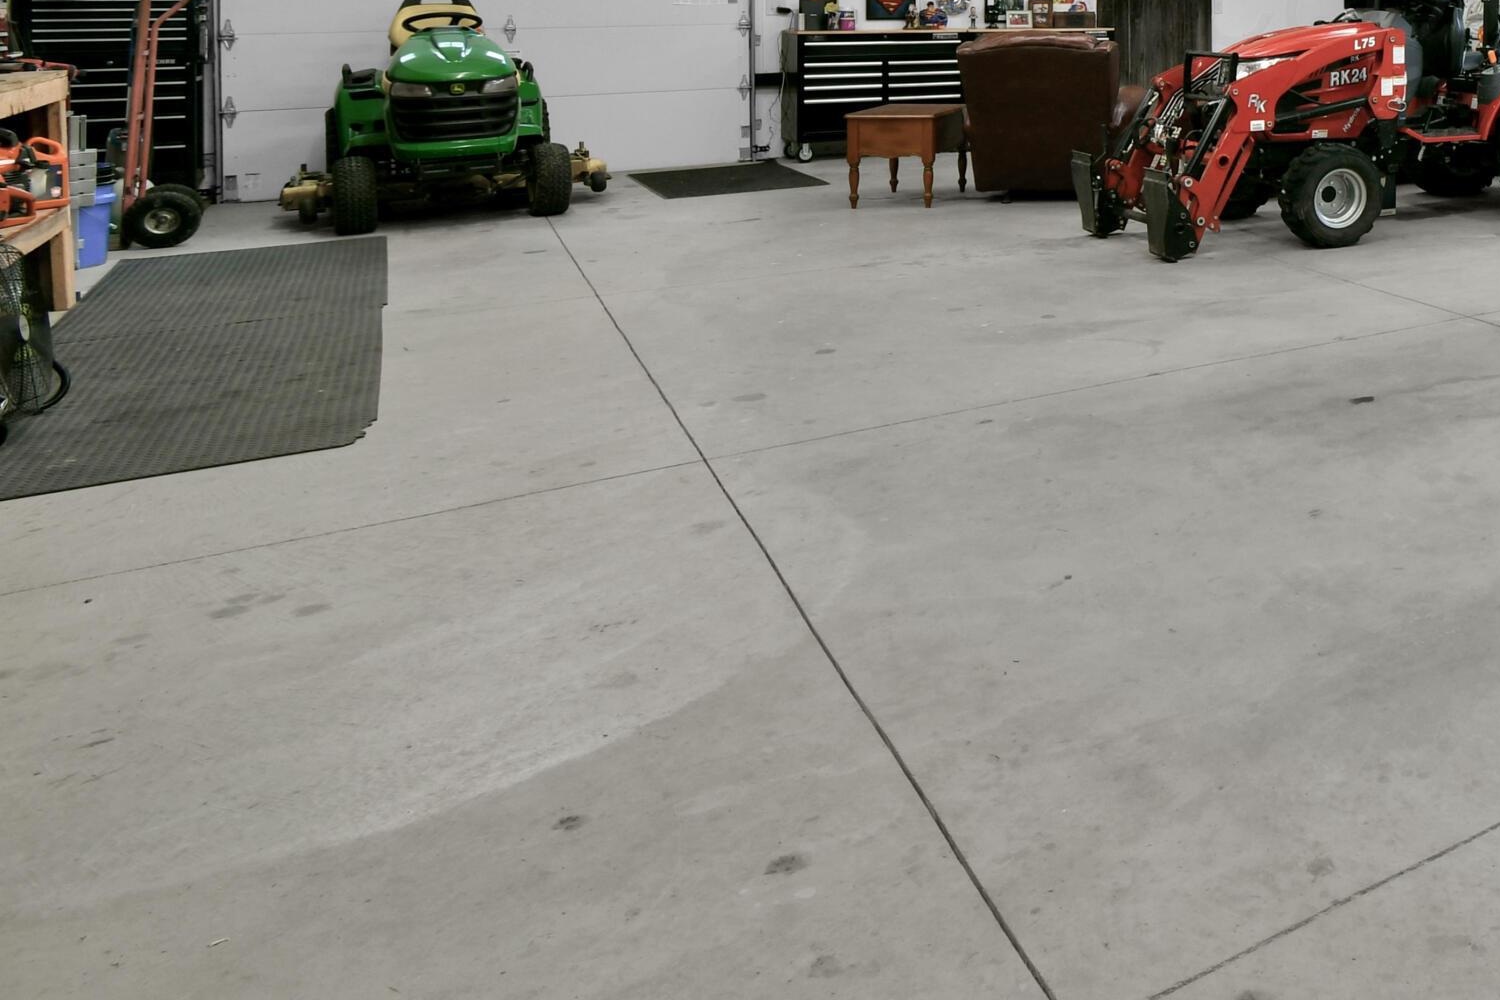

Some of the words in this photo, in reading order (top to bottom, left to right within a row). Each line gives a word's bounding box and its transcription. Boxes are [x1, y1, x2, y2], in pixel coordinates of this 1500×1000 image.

[1354, 36, 1376, 50] L75
[1330, 67, 1367, 87] RK24
[1247, 94, 1267, 113] RK
